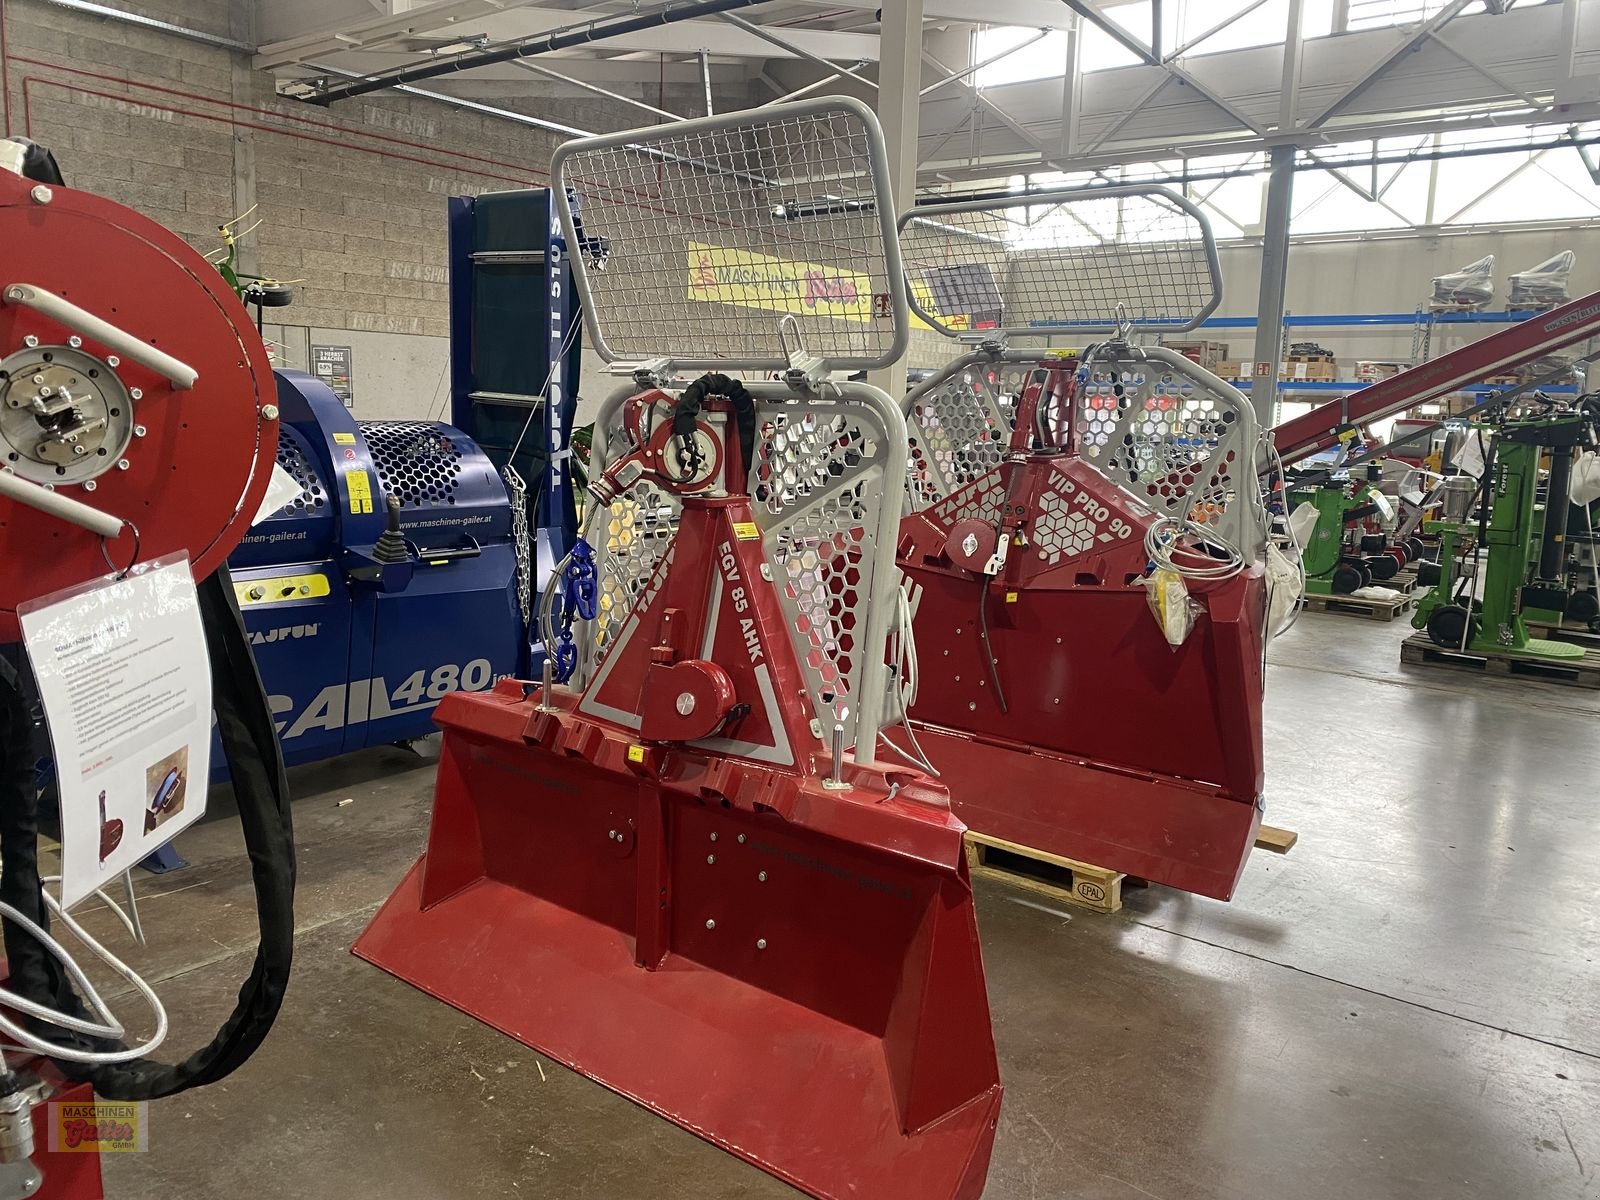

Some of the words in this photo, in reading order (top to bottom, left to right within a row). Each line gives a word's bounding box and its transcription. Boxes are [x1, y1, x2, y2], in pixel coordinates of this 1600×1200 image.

[551, 244, 561, 299] 510
[718, 267, 800, 294] MASCHINEN
[934, 470, 1003, 519] TAJFUN
[1047, 470, 1076, 494] VIP
[1073, 491, 1110, 522] PRO
[1108, 518, 1132, 540] 90
[399, 515, 492, 529] www.maschinen-gailer.at
[718, 540, 740, 581] EGV
[731, 586, 748, 613] 85
[740, 618, 764, 663] AHK
[391, 658, 492, 704] 480
[1081, 884, 1101, 900] EPAL
